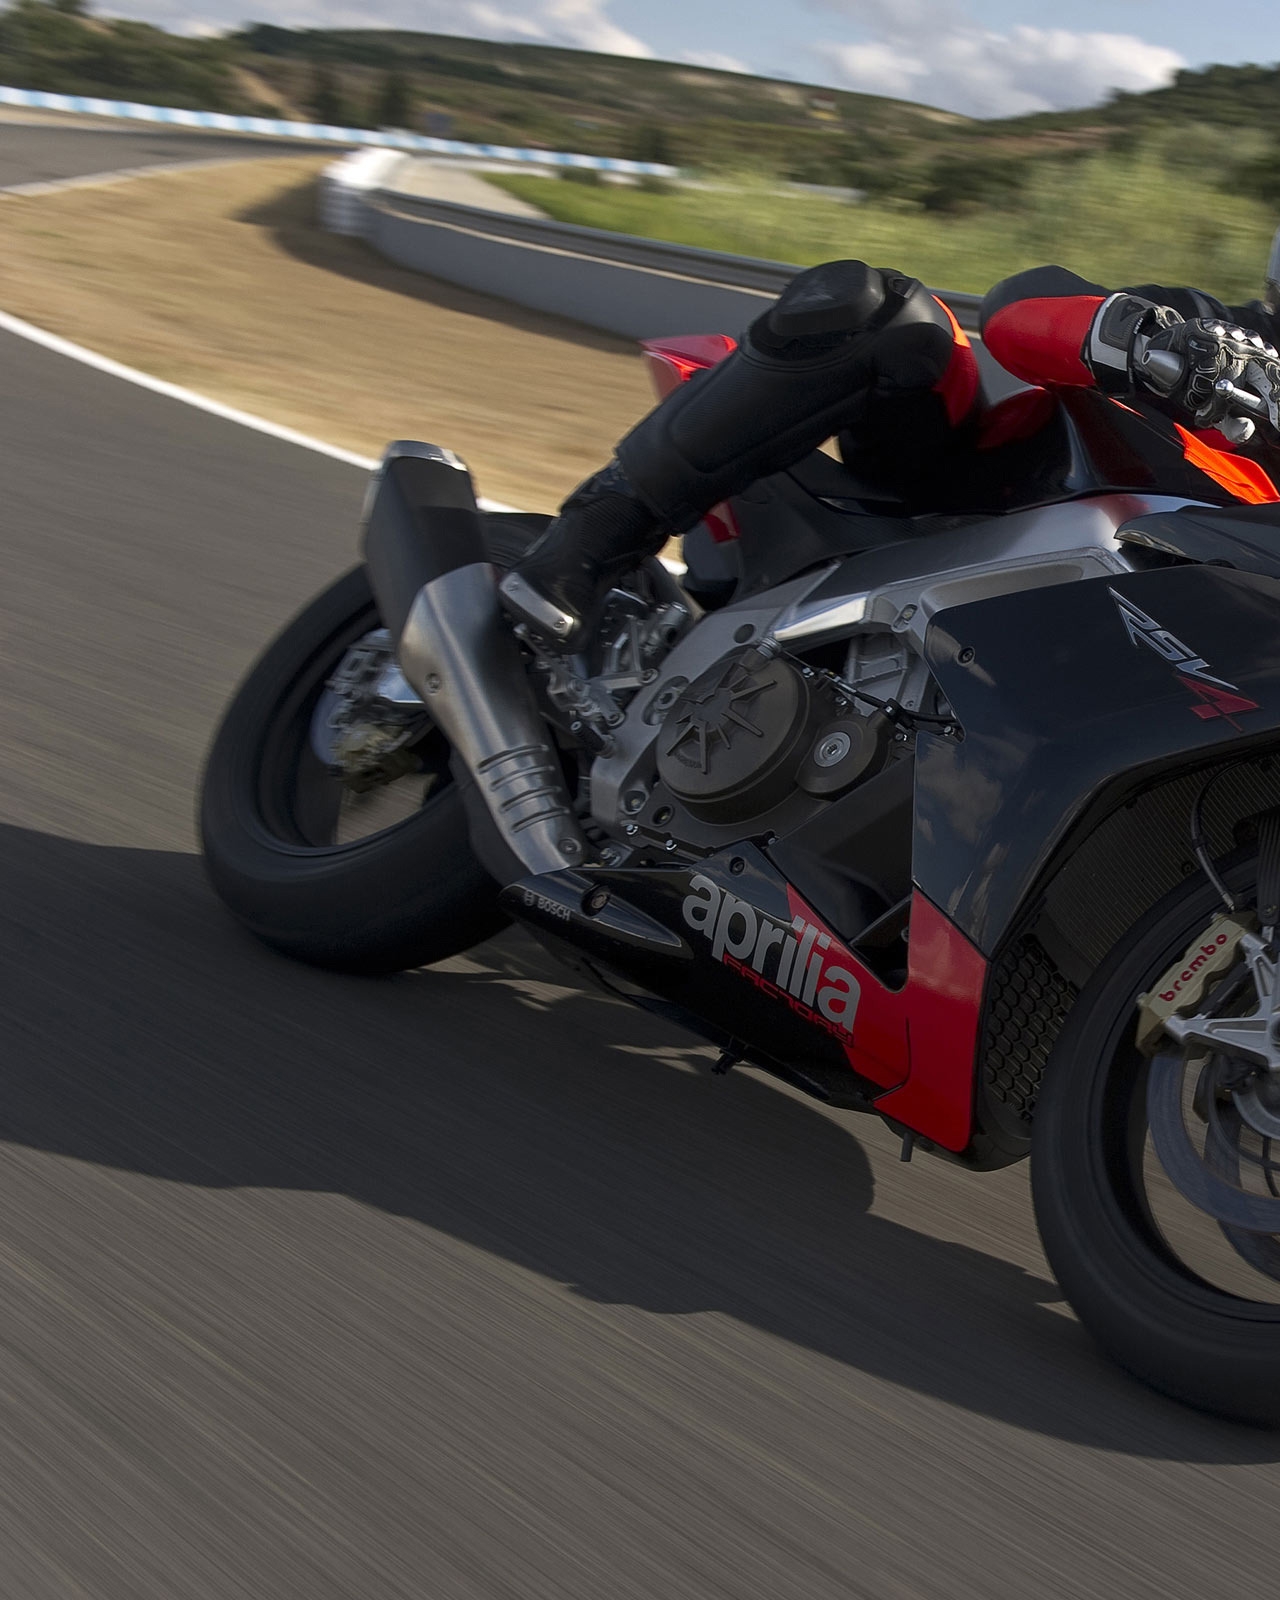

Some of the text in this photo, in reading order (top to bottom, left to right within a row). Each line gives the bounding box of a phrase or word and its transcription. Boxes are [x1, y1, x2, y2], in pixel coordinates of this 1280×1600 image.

[537, 897, 571, 921] BOSCH
[682, 874, 861, 1034] aprilia
[1158, 933, 1228, 1002] brembo
